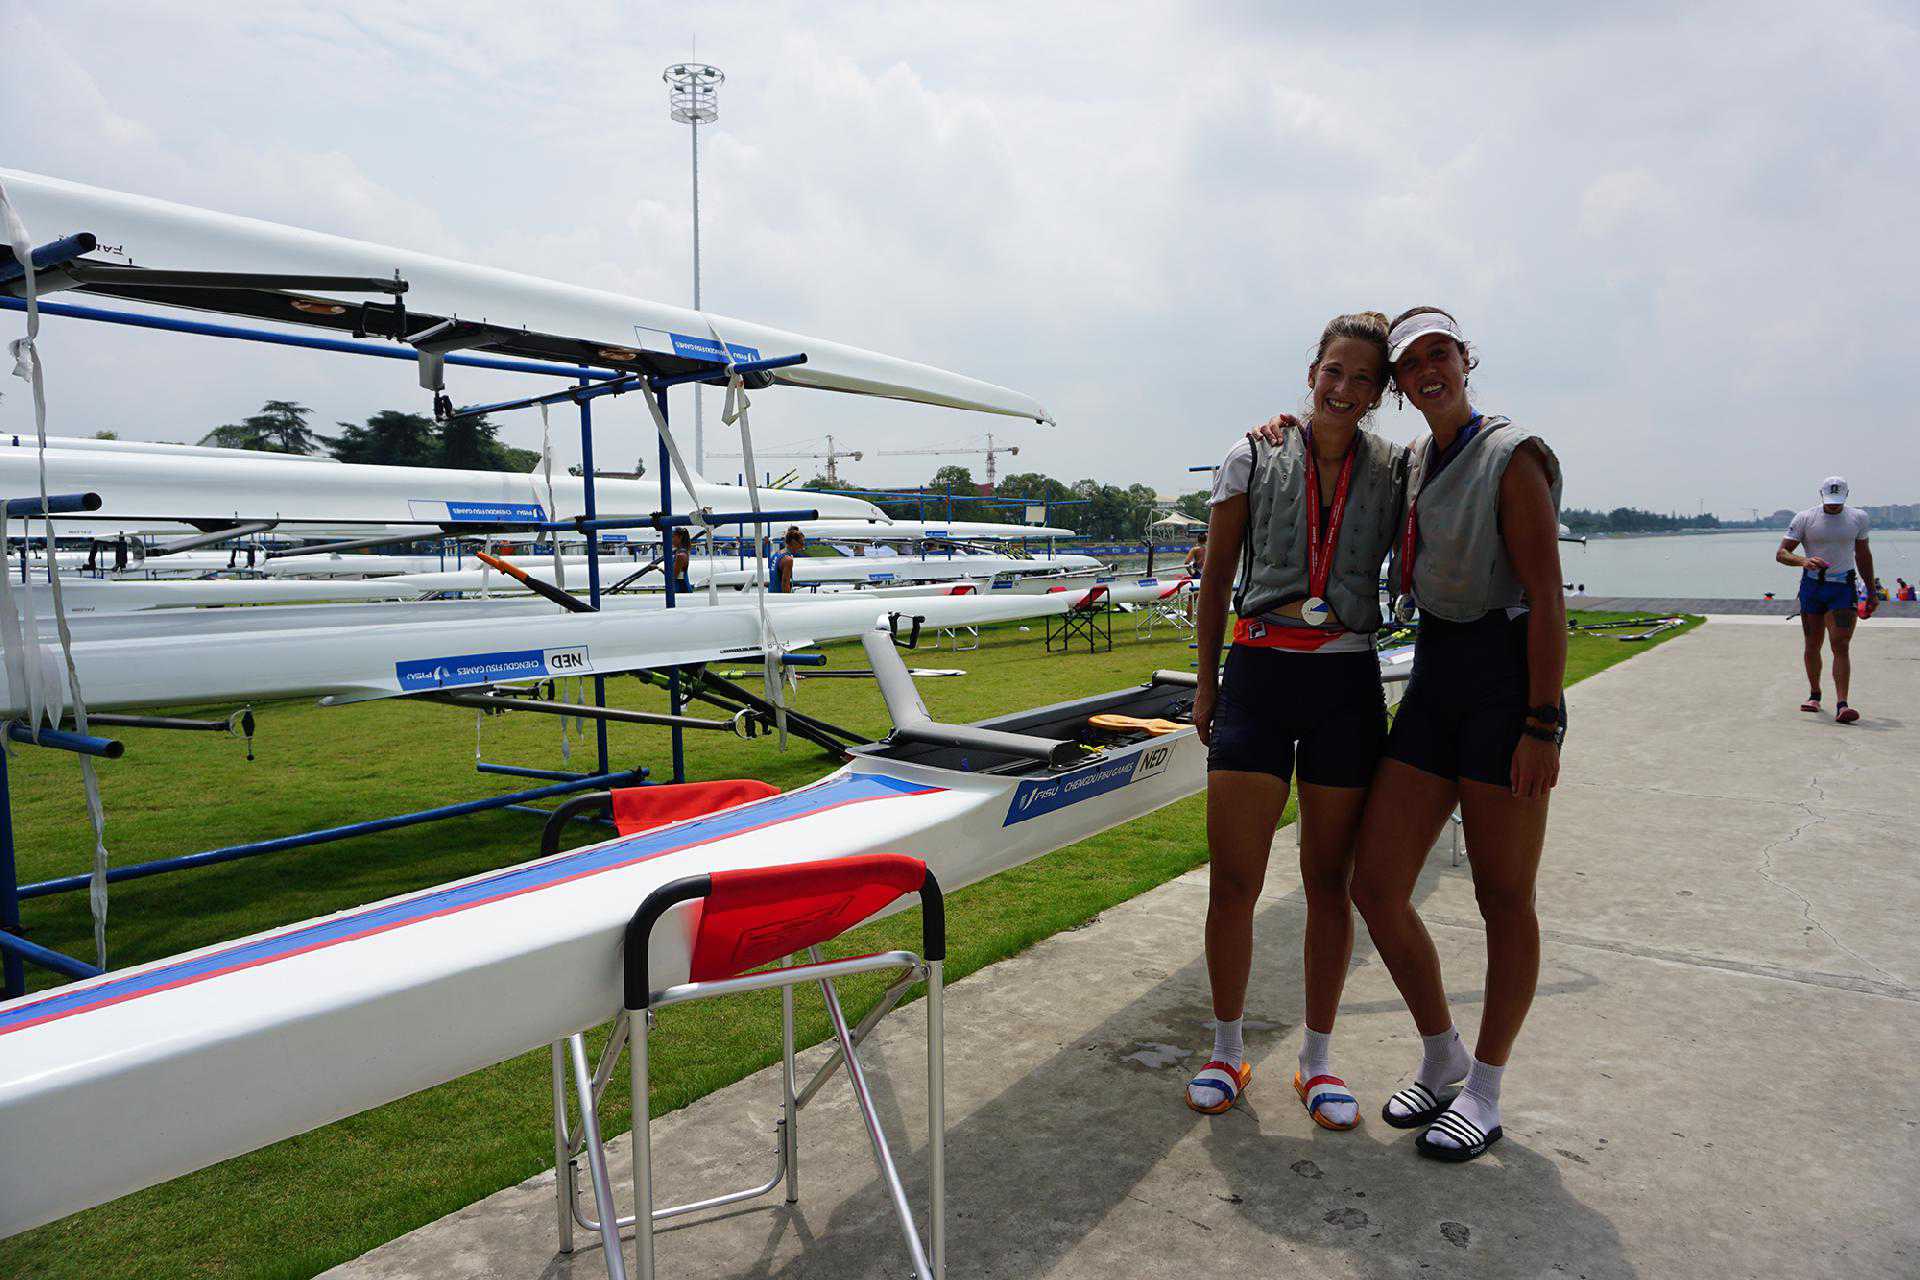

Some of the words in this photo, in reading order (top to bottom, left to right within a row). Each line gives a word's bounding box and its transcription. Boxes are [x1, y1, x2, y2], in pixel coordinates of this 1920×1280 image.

[503, 660, 539, 671] CHENGDU
[552, 653, 583, 668] NED
[457, 665, 484, 676] GAMES
[1140, 747, 1168, 772] NED
